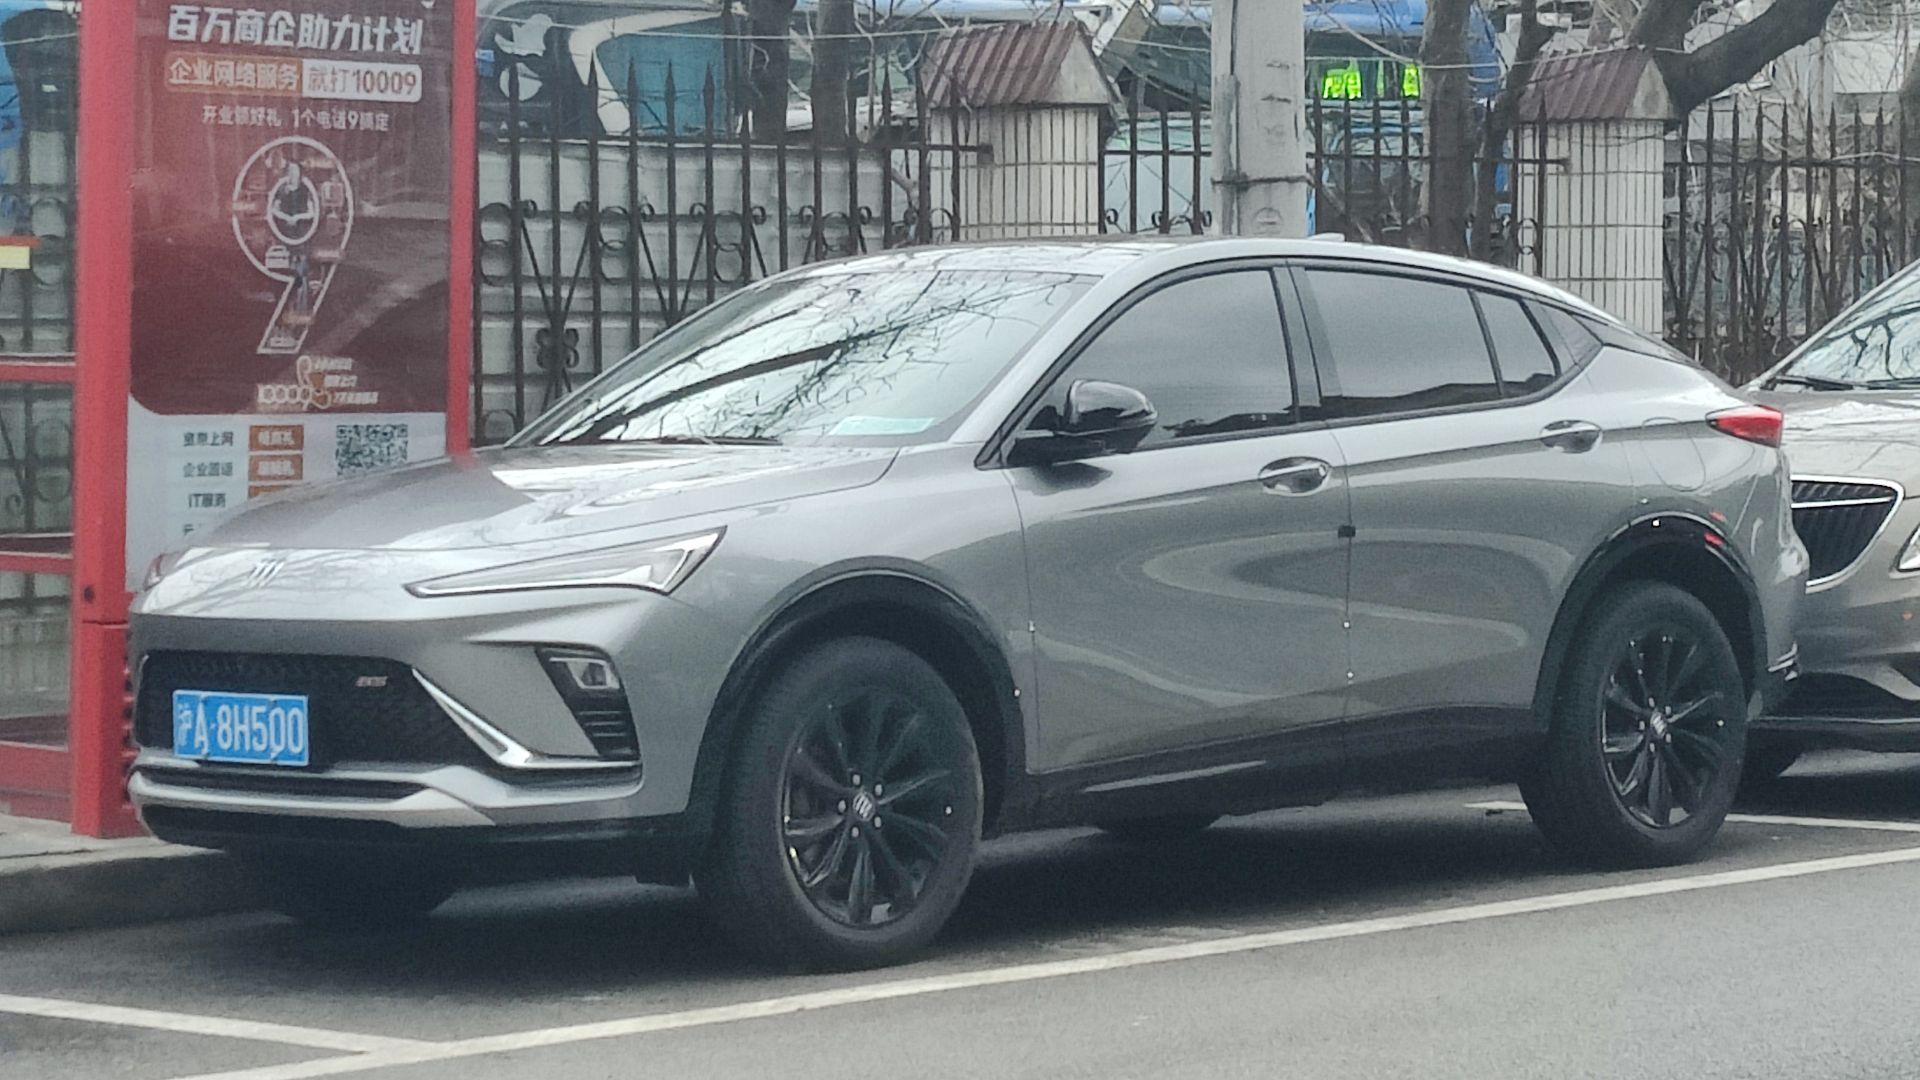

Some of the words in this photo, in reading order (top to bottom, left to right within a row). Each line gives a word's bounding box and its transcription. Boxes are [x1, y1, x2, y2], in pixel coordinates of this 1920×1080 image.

[168, 5, 424, 54] 百万商企助力计划
[168, 57, 300, 91] 企业网络服务
[308, 65, 417, 96] 就打10009
